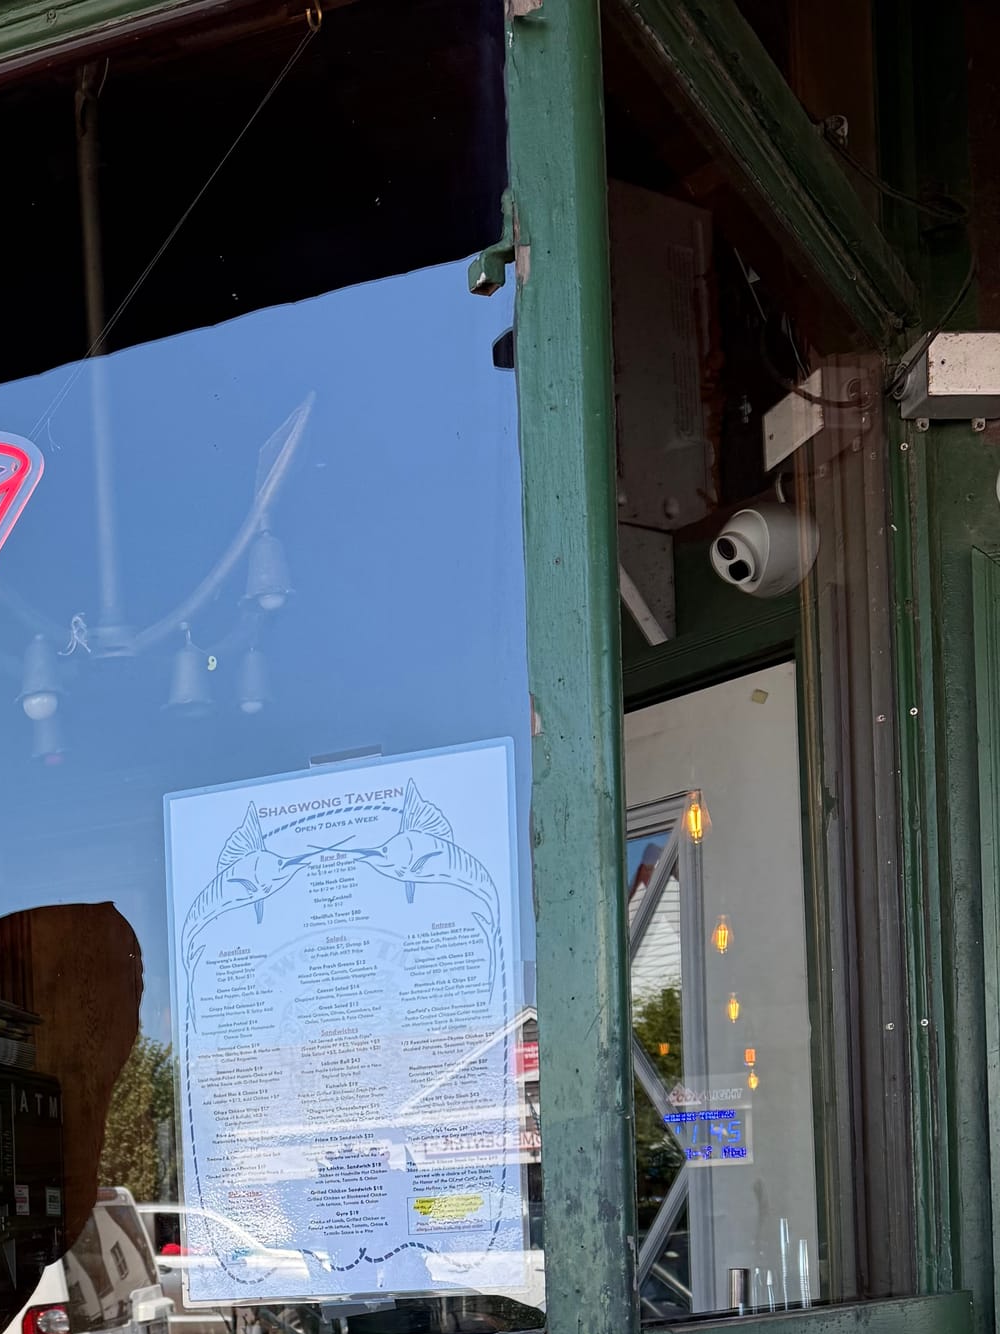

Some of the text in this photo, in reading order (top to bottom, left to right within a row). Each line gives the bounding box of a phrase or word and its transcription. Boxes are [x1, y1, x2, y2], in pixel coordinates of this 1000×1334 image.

[259, 787, 404, 818] SHAGWONG TAVERN
[295, 825, 317, 833] OPEN
[325, 820, 346, 829] DAYS
[355, 815, 379, 823] WEEK
[19, 1089, 58, 1119] ATM
